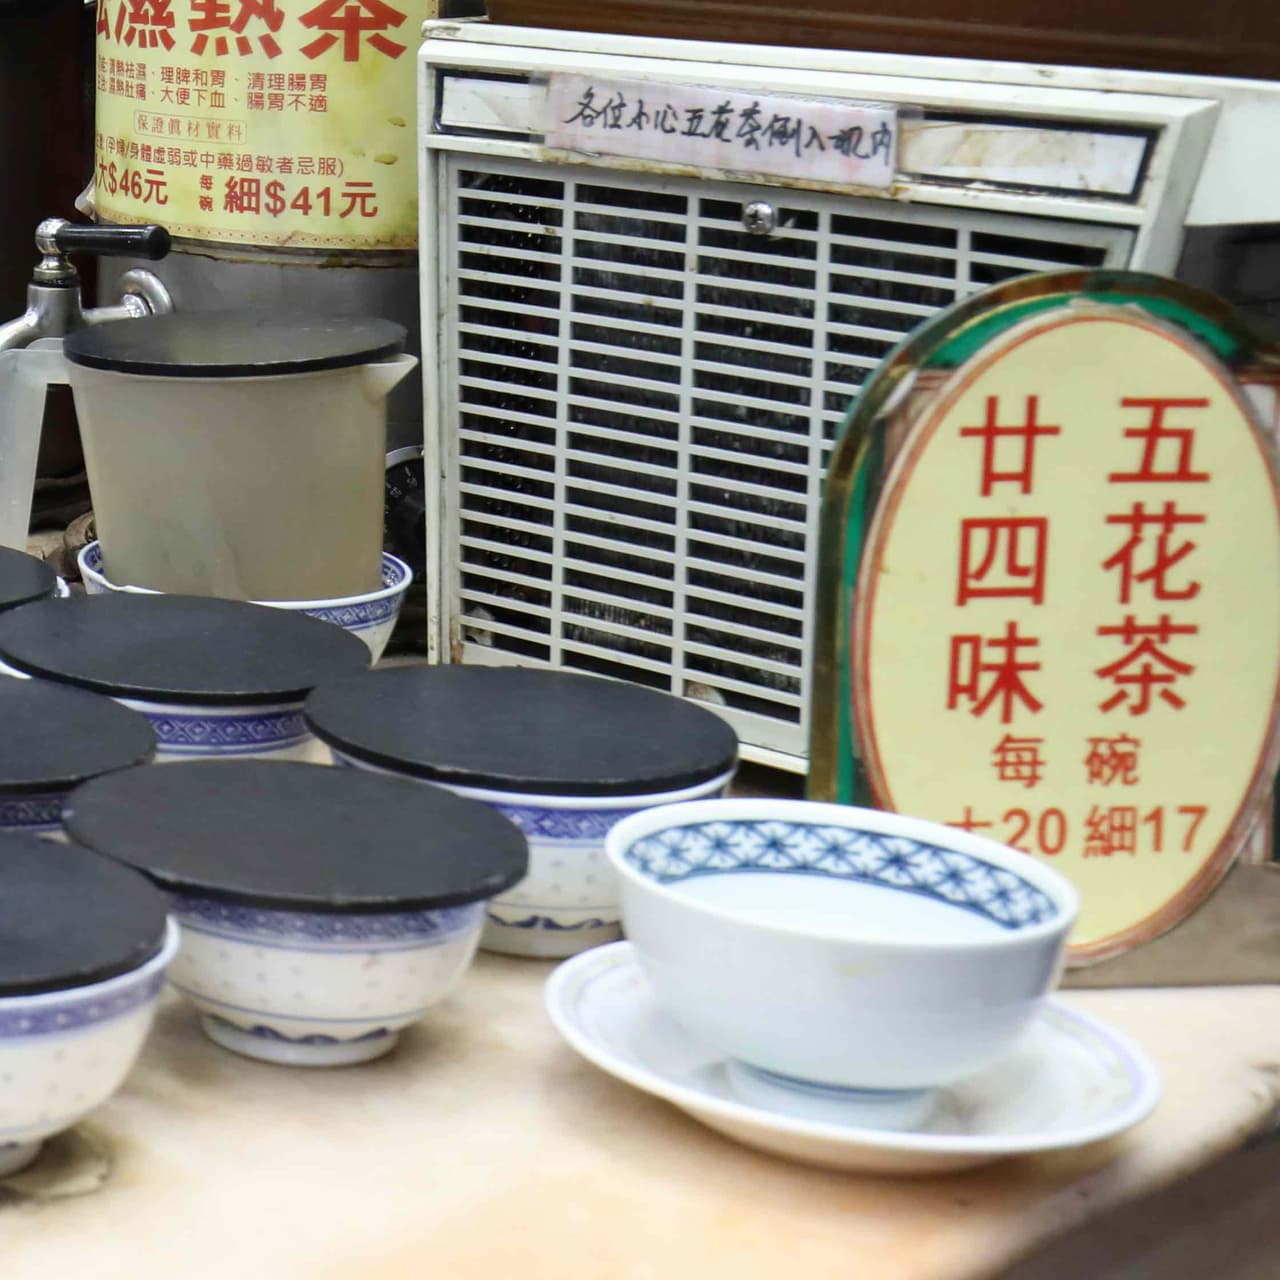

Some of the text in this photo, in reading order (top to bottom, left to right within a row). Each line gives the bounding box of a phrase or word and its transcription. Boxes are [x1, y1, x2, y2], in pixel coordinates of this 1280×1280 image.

[224, 176, 378, 219] 細$41元
[946, 394, 1062, 724] 廿四味
[1094, 396, 1211, 718] 五花茶
[991, 733, 1141, 789] 每碗
[1083, 804, 1210, 859] 細17
